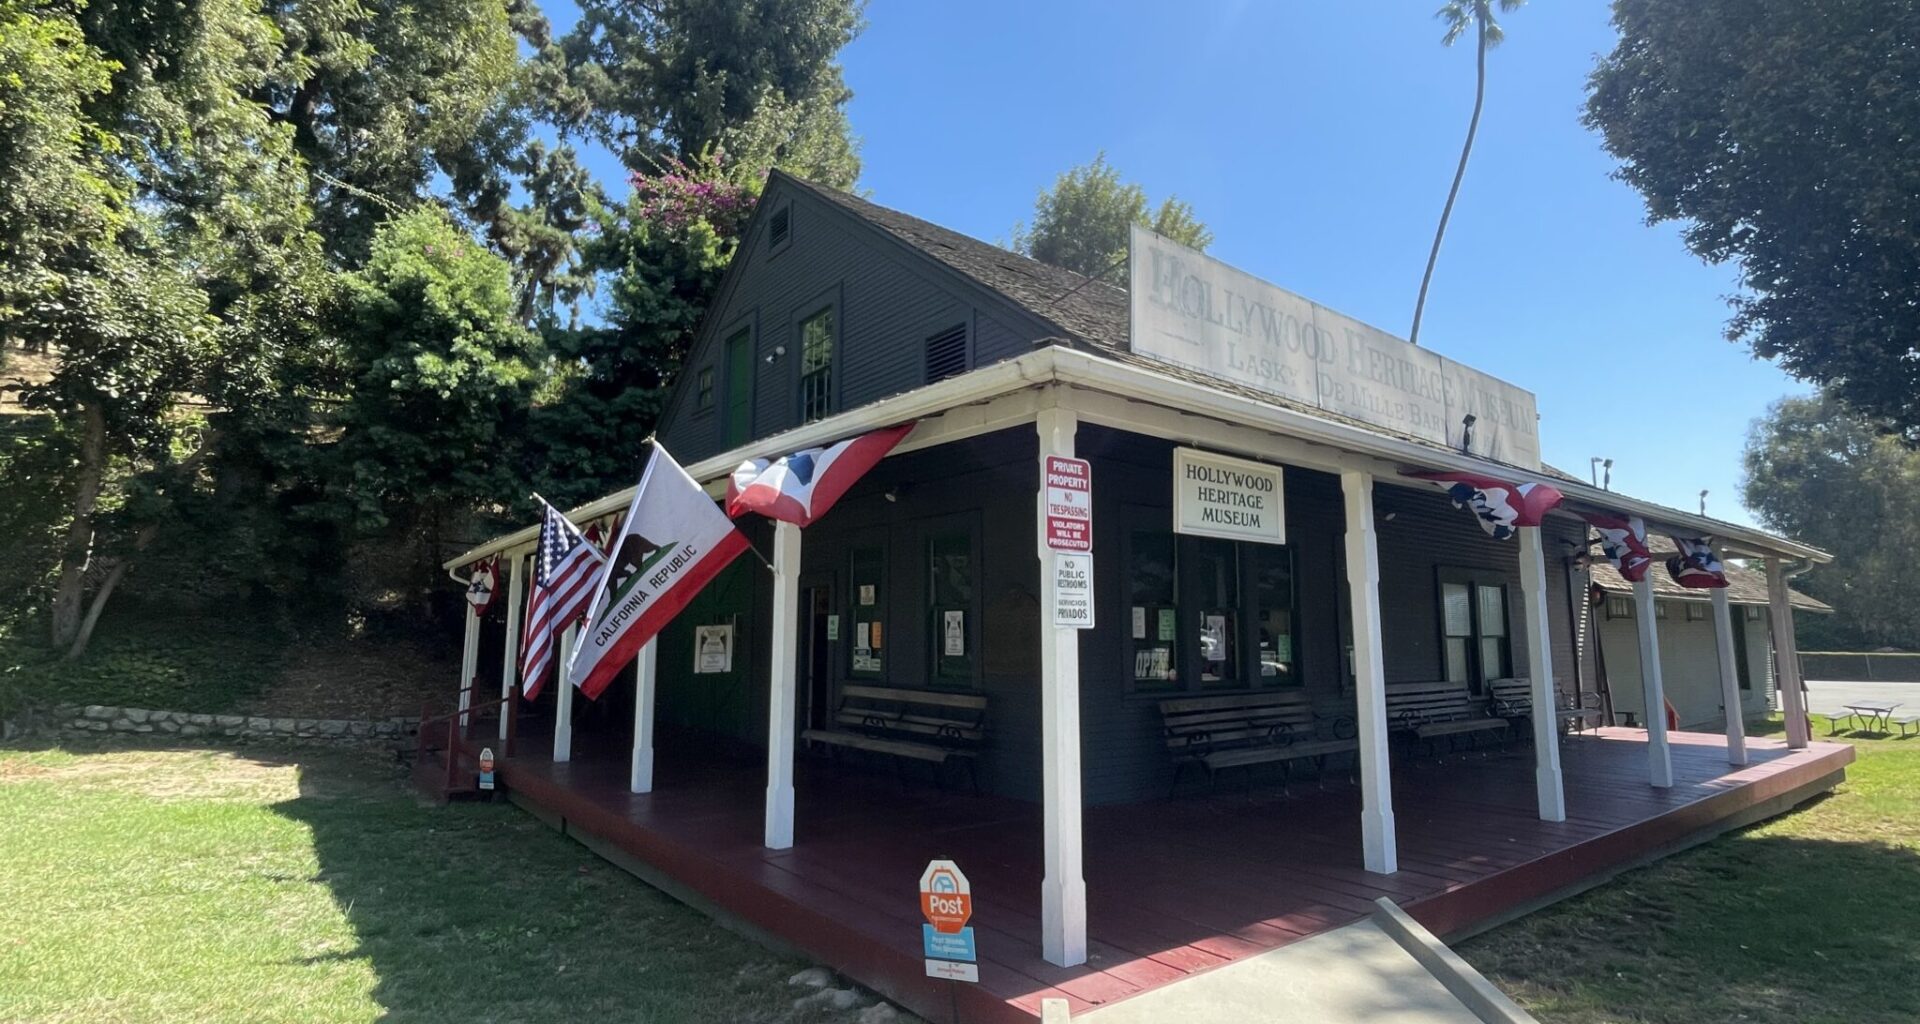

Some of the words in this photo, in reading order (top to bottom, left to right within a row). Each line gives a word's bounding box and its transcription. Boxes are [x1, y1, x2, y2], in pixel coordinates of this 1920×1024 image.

[1149, 246, 1336, 364] HOLLYWOOD
[1344, 328, 1455, 407] HERITAGE
[1456, 372, 1535, 435] MUSEUM
[1053, 461, 1083, 475] PRIVATE
[1048, 474, 1088, 489] PROPERTY
[1186, 464, 1273, 492] HOLLYWOOD
[1064, 492, 1073, 503] NO
[1198, 486, 1264, 509] HERITAGE
[1049, 503, 1088, 518] TRESPASSING
[1202, 507, 1261, 528] MUSEUM
[1052, 520, 1085, 531] VIOLATORS
[1056, 530, 1071, 538] WILL
[1073, 531, 1081, 539] BE
[1049, 538, 1088, 548] PROSECUTED
[1064, 560, 1075, 569] NO
[1059, 570, 1085, 579] PUBLIC
[1058, 579, 1087, 589] RESTROOMS
[594, 589, 650, 647] CALIFORNIA
[649, 545, 697, 590] REPUBLIC
[1058, 608, 1087, 619] PRIVADOS
[929, 895, 964, 915] Post
